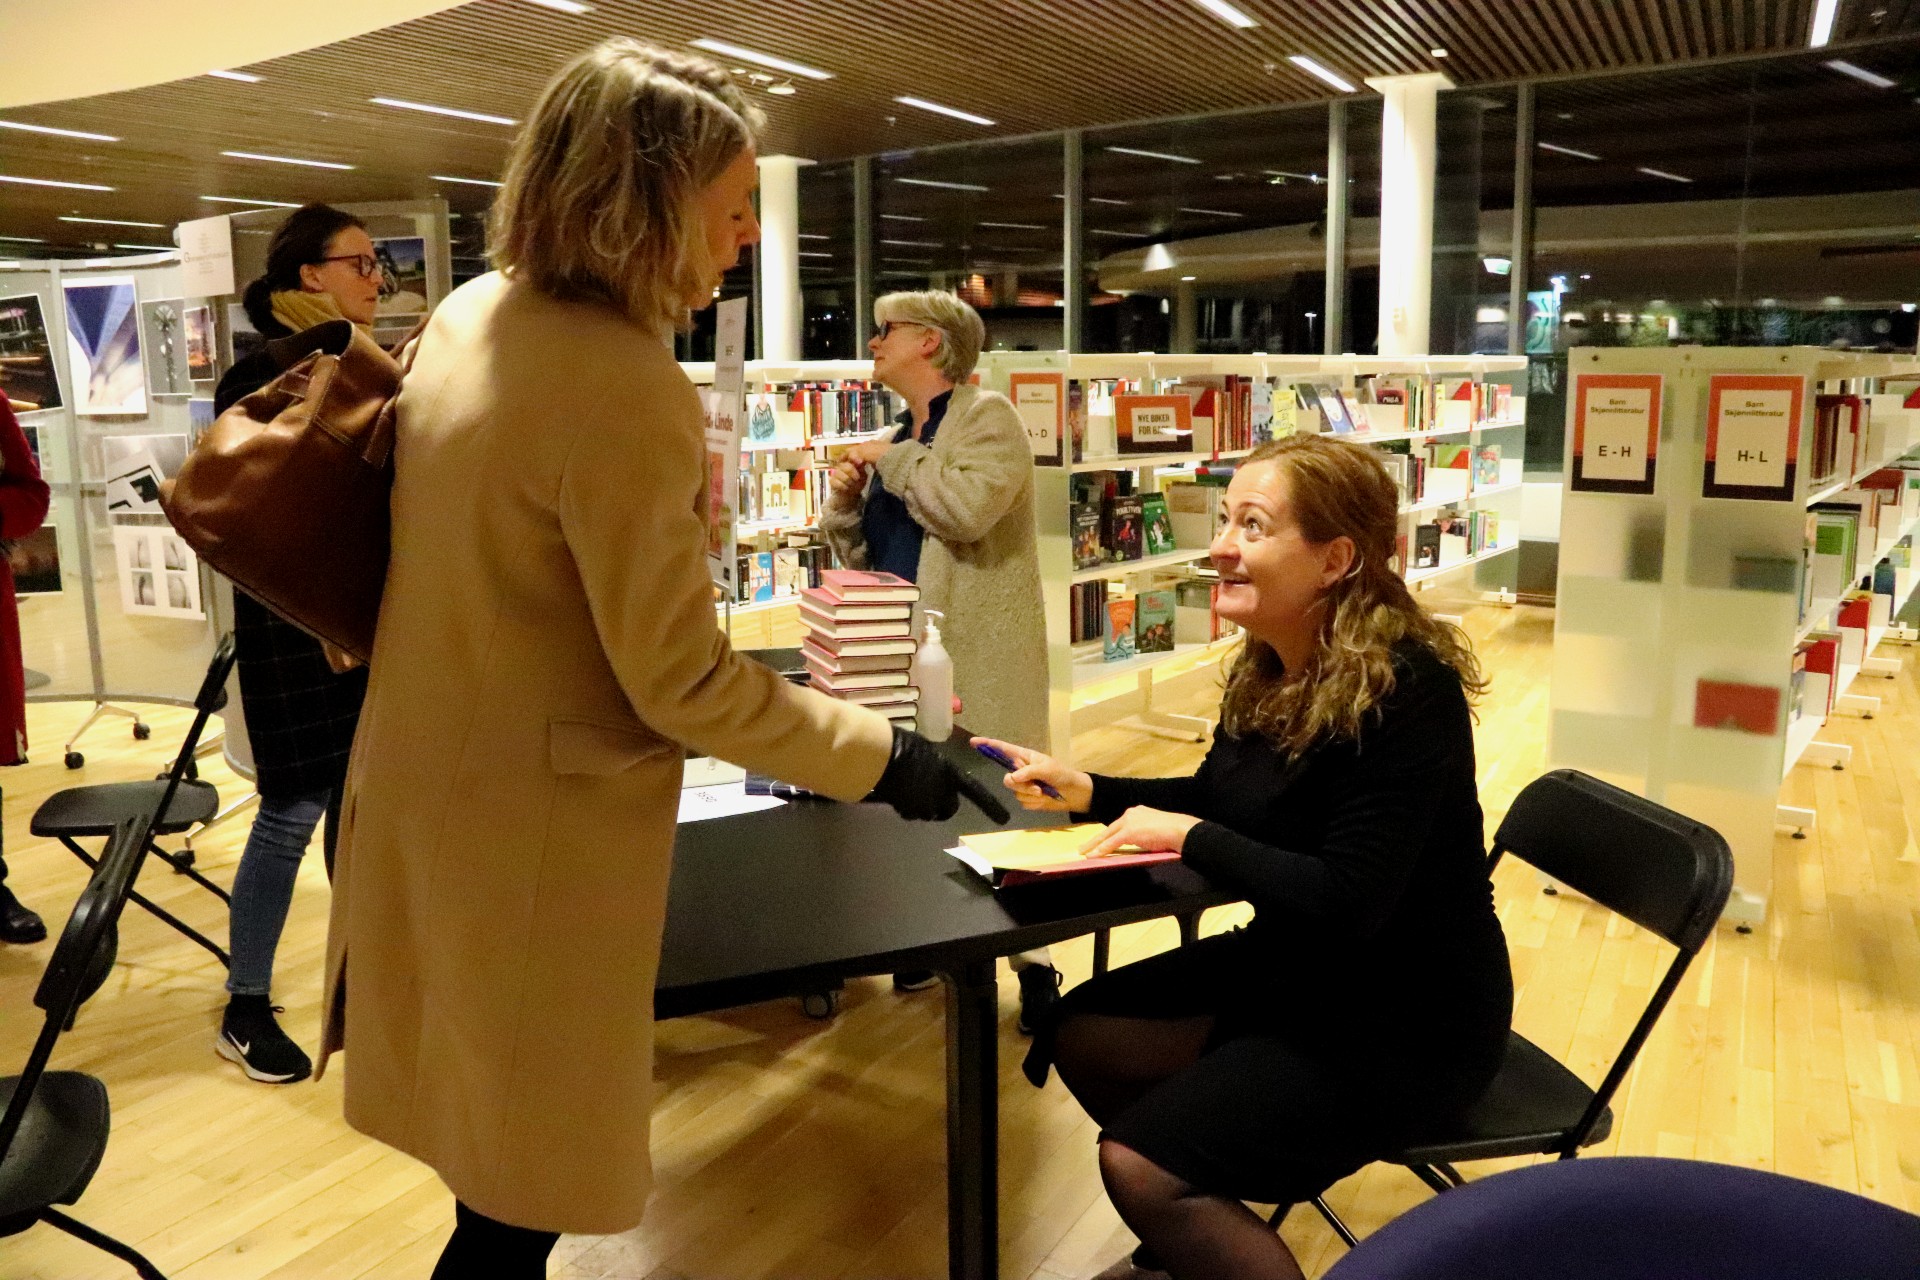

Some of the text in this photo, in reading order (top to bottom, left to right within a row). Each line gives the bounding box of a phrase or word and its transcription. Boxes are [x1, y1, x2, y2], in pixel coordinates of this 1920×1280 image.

[1138, 414, 1149, 422] NYE
[1138, 426, 1151, 435] FOR
[1599, 445, 1608, 457] E
[1621, 446, 1631, 457] H
[1759, 451, 1768, 463] L
